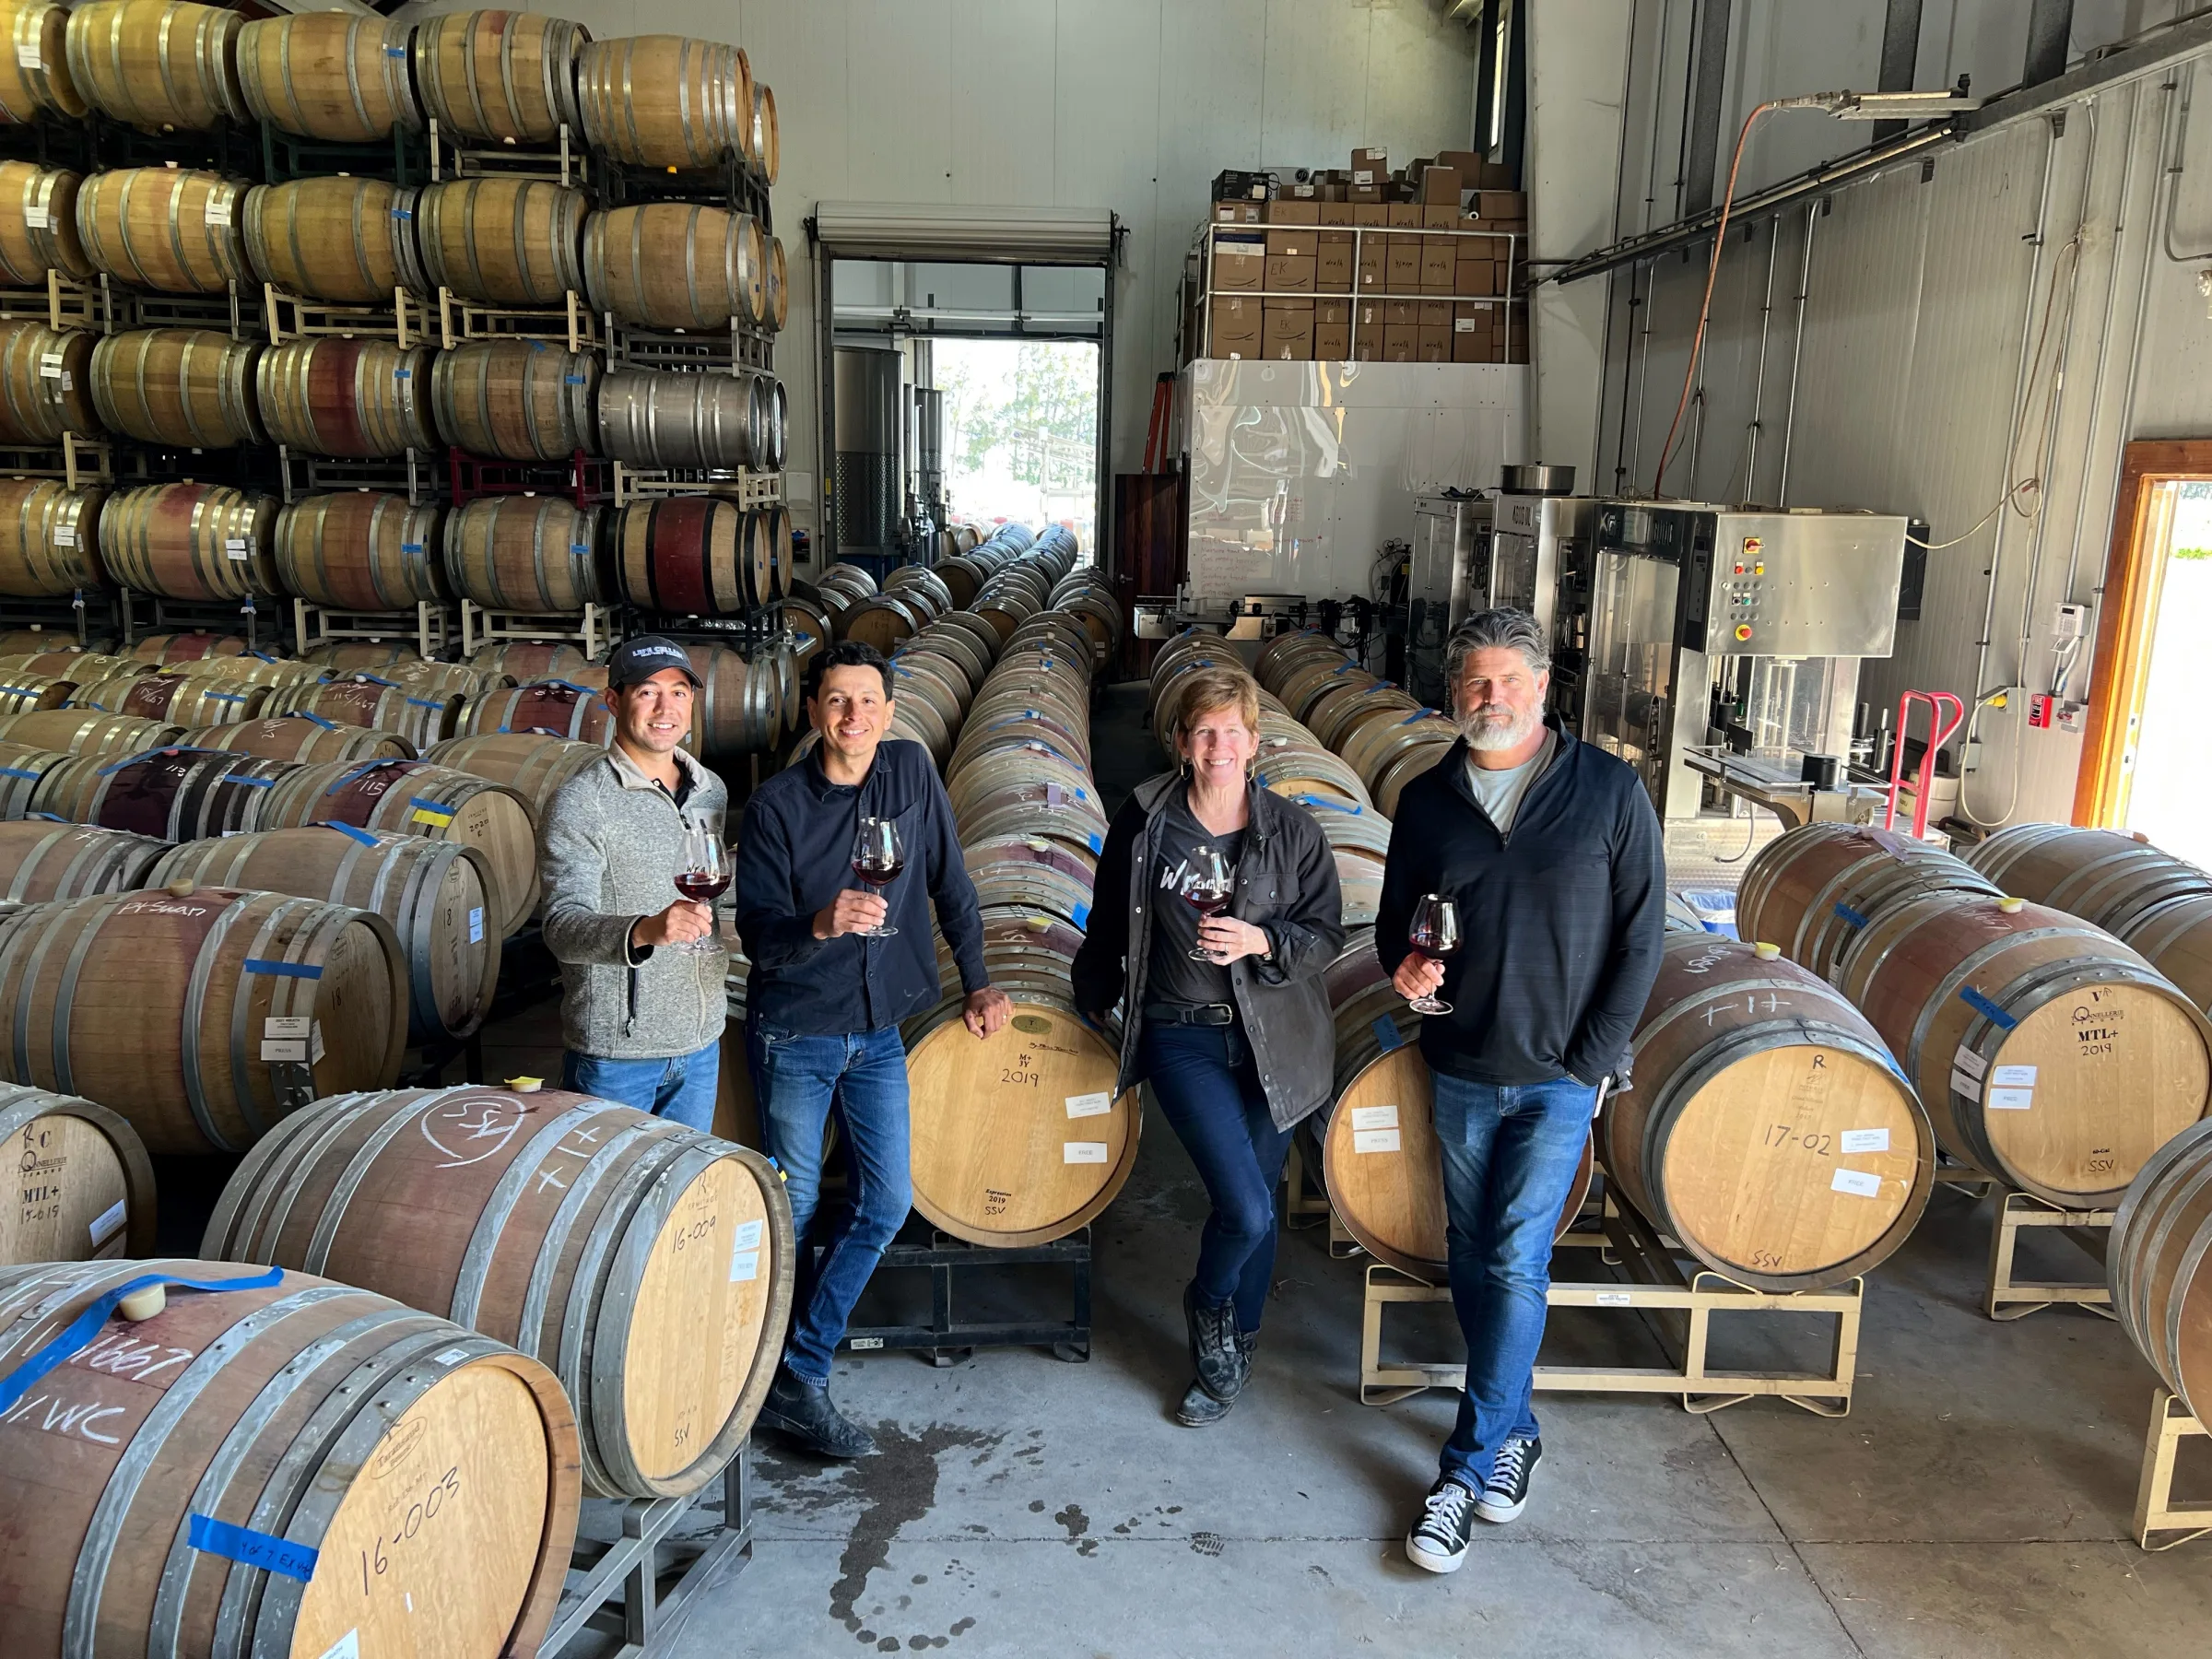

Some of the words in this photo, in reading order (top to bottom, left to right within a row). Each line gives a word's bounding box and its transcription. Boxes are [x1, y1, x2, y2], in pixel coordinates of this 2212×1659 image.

[1274, 206, 1287, 218] EK
[1270, 261, 1288, 276] EK
[1279, 319, 1291, 330] EK
[468, 818, 489, 832] 2020
[331, 986, 342, 1011] 18
[2077, 1028, 2119, 1042] MTL+
[2080, 1042, 2112, 1056] 2019
[1812, 1054, 1827, 1069] R
[1001, 1068, 1040, 1088] 2019
[1764, 1124, 1831, 1157] 17-02
[2088, 1159, 2114, 1172] SSV
[22, 1185, 59, 1205] MTL+
[988, 1196, 1006, 1205] 2019
[984, 1206, 1006, 1216] SSV
[672, 1215, 716, 1253] 16-009
[1752, 1249, 1783, 1267] SSV
[42, 1397, 125, 1444] WC
[362, 1465, 460, 1596] 16-003
